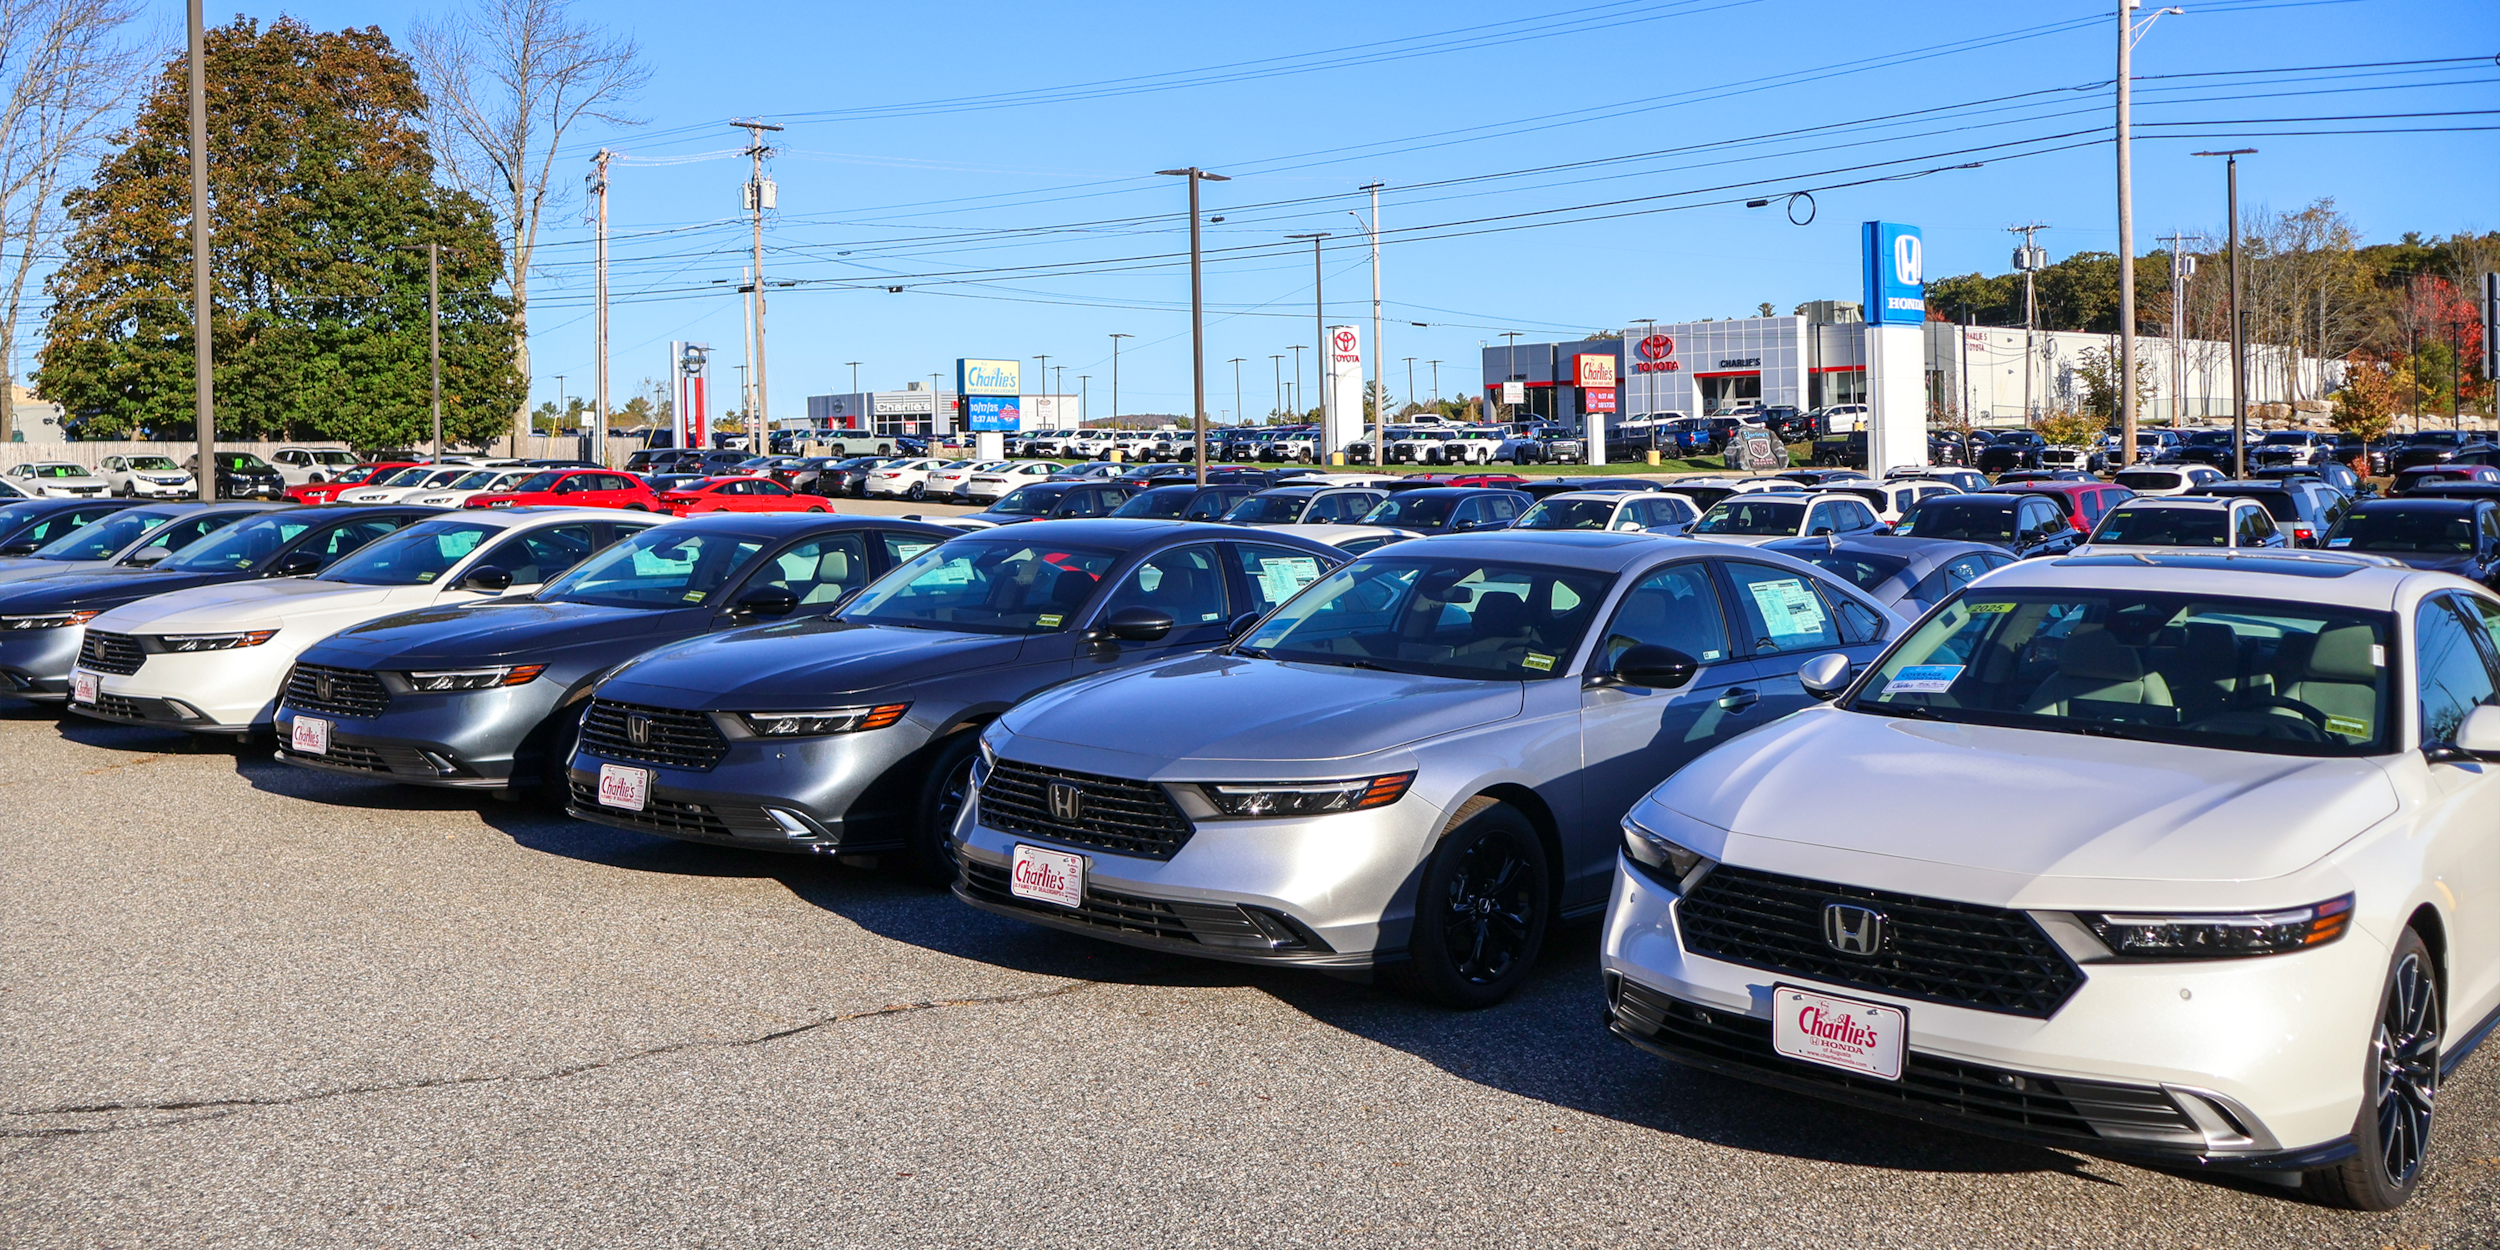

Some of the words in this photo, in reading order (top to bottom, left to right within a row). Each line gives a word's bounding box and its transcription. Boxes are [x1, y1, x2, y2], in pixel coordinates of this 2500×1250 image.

[1887, 297, 1925, 311] HONDA
[1966, 343, 1985, 352] TOYOTA
[1720, 358, 1761, 368] CHARLIE'S
[968, 366, 1017, 388] Charlie's
[1582, 361, 1613, 381] Charlie's
[876, 402, 931, 412] Charlie's
[970, 402, 999, 414] 10/17/25
[973, 415, 986, 423] 8:37
[986, 415, 998, 423] AM
[1972, 604, 2004, 612] 2025
[295, 725, 320, 744] Charlie's
[602, 776, 635, 798] Charlie's
[1016, 860, 1065, 890] Charlie's
[1038, 887, 1062, 896] DEALERSHIPS
[1799, 1006, 1878, 1048] Charlie's
[1820, 1039, 1865, 1055] HONDA
[1829, 1047, 1852, 1059] Augusta
[1806, 1050, 1868, 1067] www.charlieshonda.com
